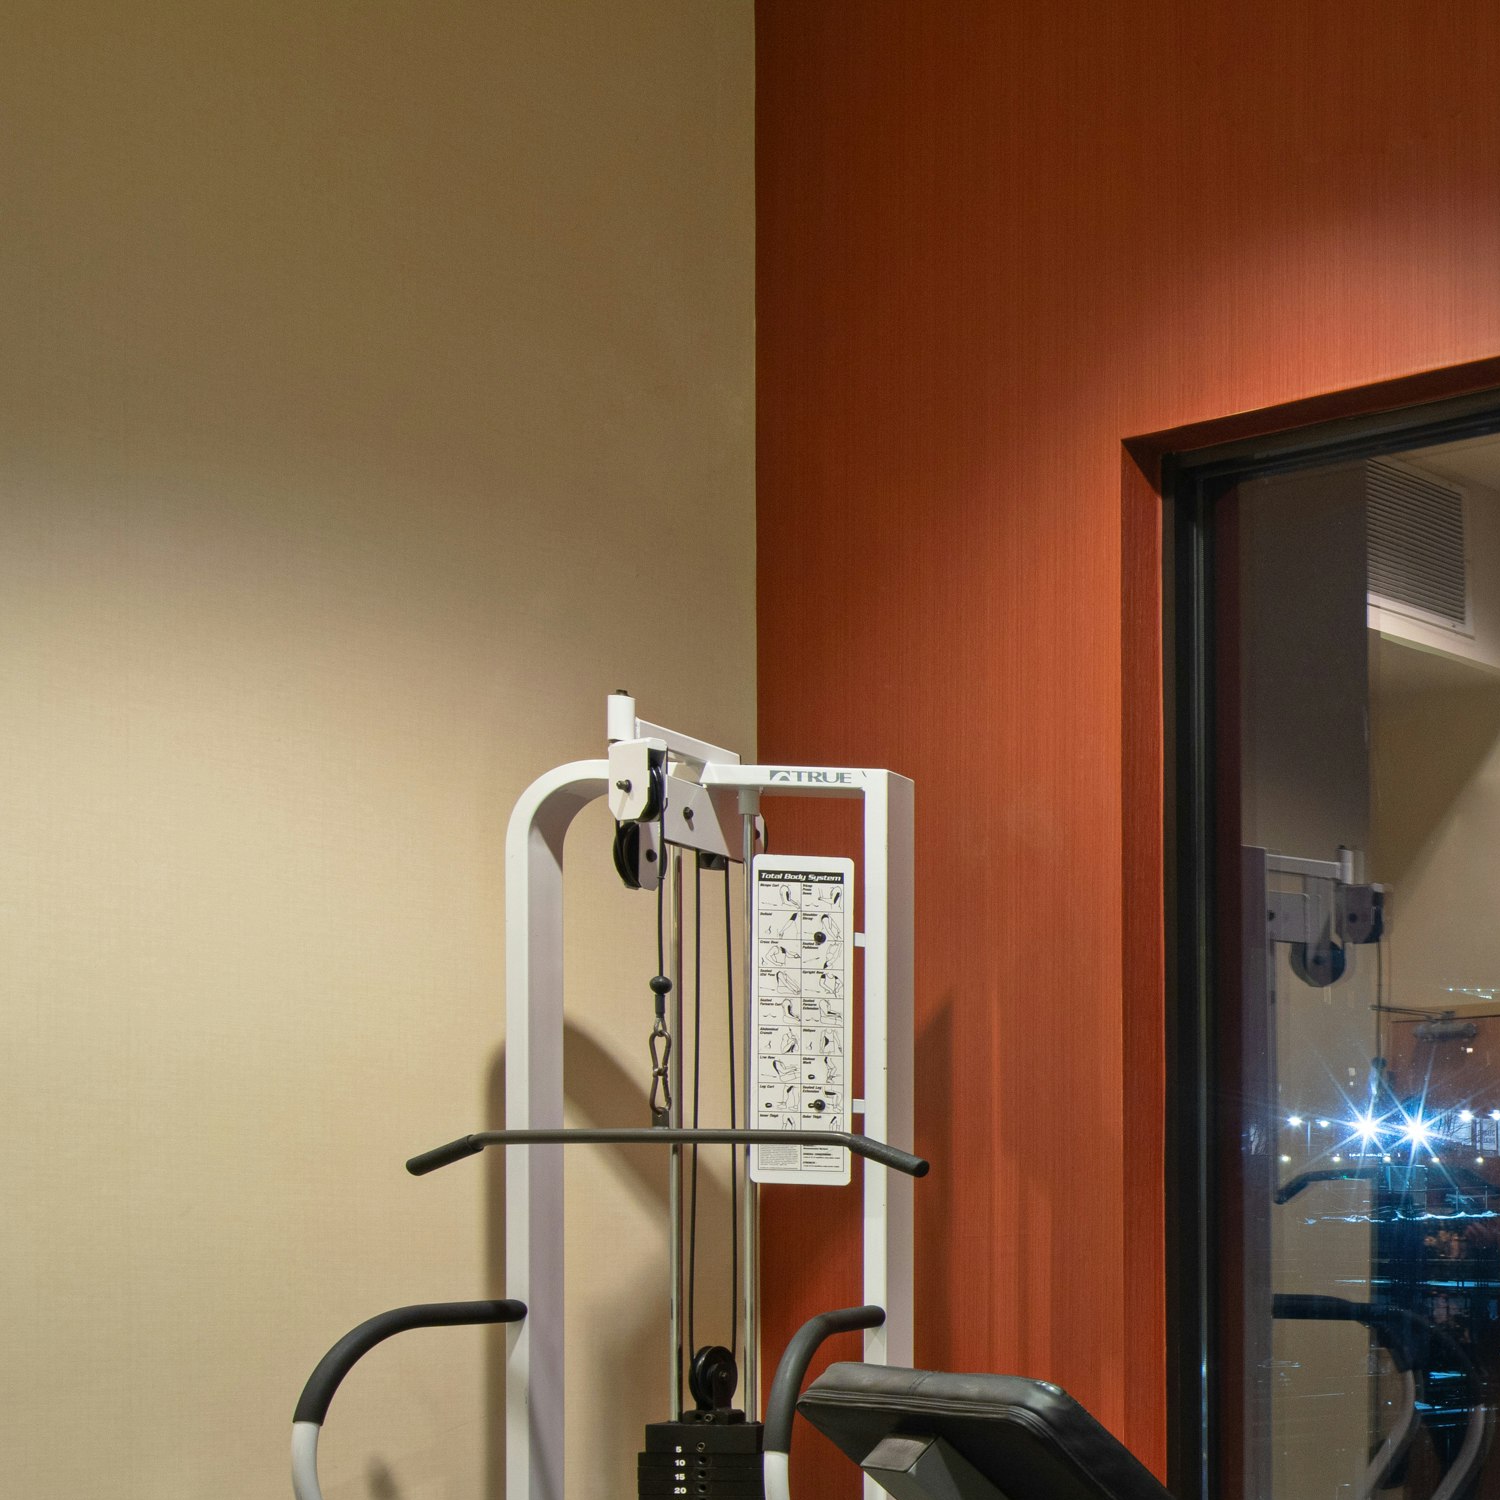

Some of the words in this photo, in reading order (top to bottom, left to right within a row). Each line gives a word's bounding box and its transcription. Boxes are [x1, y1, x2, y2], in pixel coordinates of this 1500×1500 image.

[791, 770, 852, 784] TRUE
[761, 872, 783, 880] Total
[784, 873, 806, 881] Body
[808, 874, 841, 882] System
